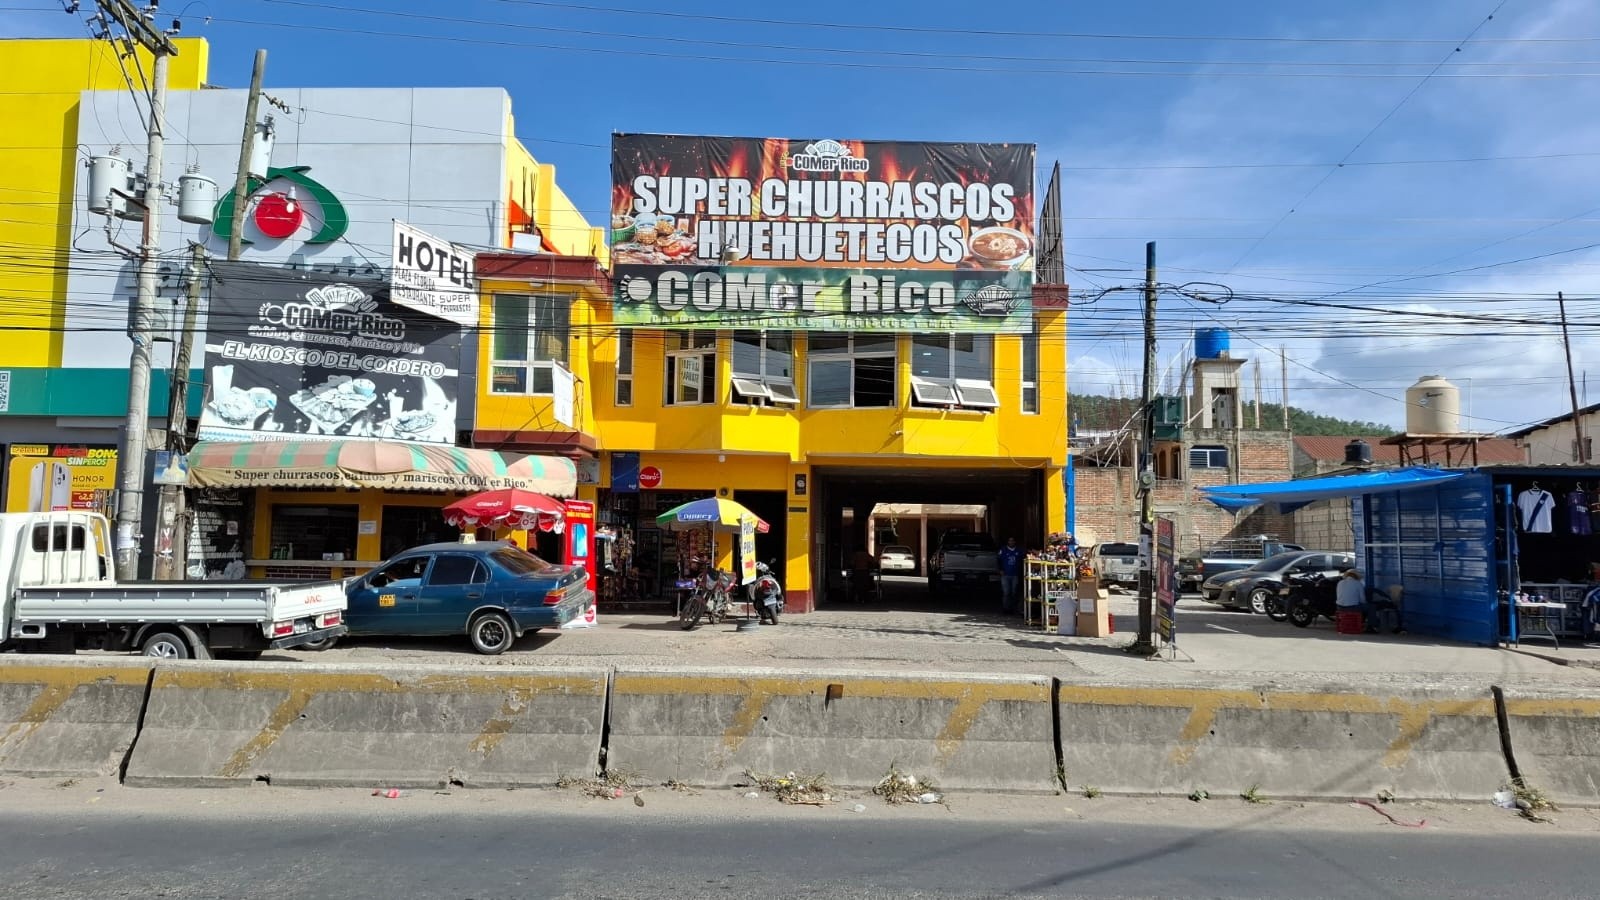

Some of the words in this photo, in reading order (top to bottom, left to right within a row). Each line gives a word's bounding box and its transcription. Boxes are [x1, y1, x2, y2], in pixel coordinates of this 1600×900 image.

[839, 156, 869, 172] Rico
[633, 175, 752, 216] SUPER
[761, 179, 1016, 221] CHURRASCOS
[698, 220, 965, 263] HUEHUETECOS
[399, 232, 473, 290] HOTEL
[656, 270, 826, 311] COMer
[850, 275, 956, 312] Rico
[358, 312, 405, 340] Rico
[222, 340, 248, 361] EL
[248, 343, 323, 367] KIOSCO
[323, 350, 359, 370] DEL
[360, 354, 446, 378] CORDERO
[72, 475, 105, 483] HONOR
[305, 594, 322, 604] JAC
